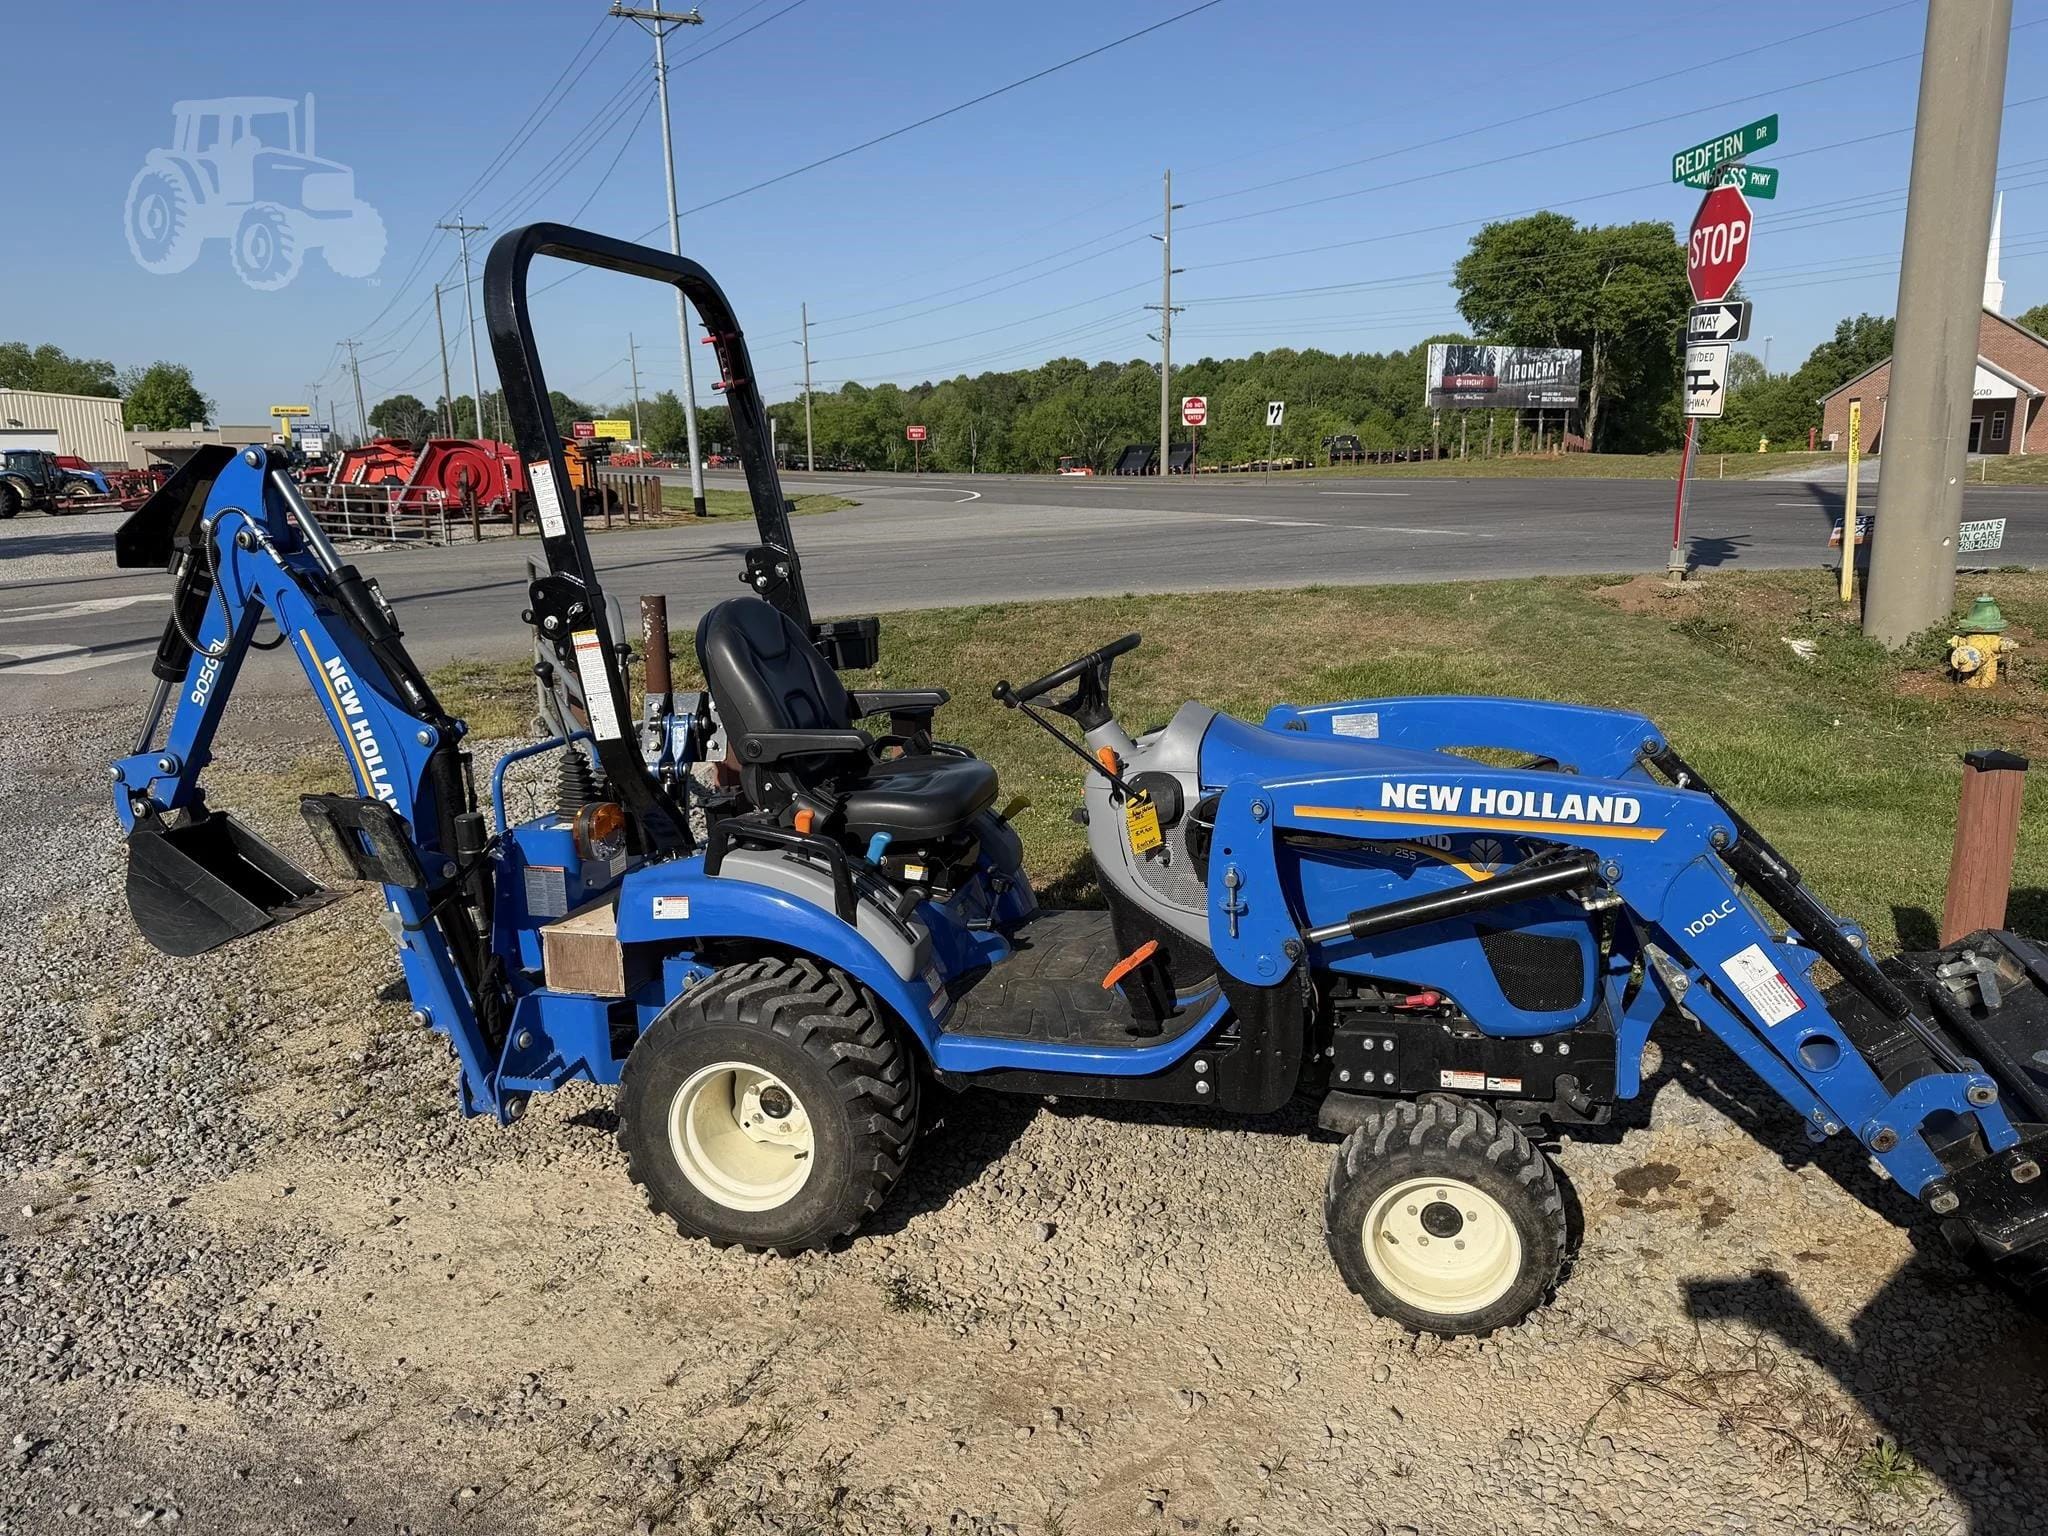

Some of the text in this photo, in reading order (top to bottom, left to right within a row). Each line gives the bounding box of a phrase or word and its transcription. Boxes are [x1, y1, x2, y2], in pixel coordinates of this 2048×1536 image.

[1675, 126, 1767, 178] REDFERN DR
[1751, 172, 1771, 186] PKWY
[1690, 220, 1746, 269] STOP
[1699, 315, 1720, 330] WAY
[1509, 360, 1568, 380] IRONCRAFT
[1974, 388, 1993, 396] GOD
[1973, 530, 2001, 540] CARE
[324, 656, 401, 815] NEW HOLLA
[1381, 782, 1641, 824] NEW HOLLAND
[1683, 899, 1737, 937] 100LC
